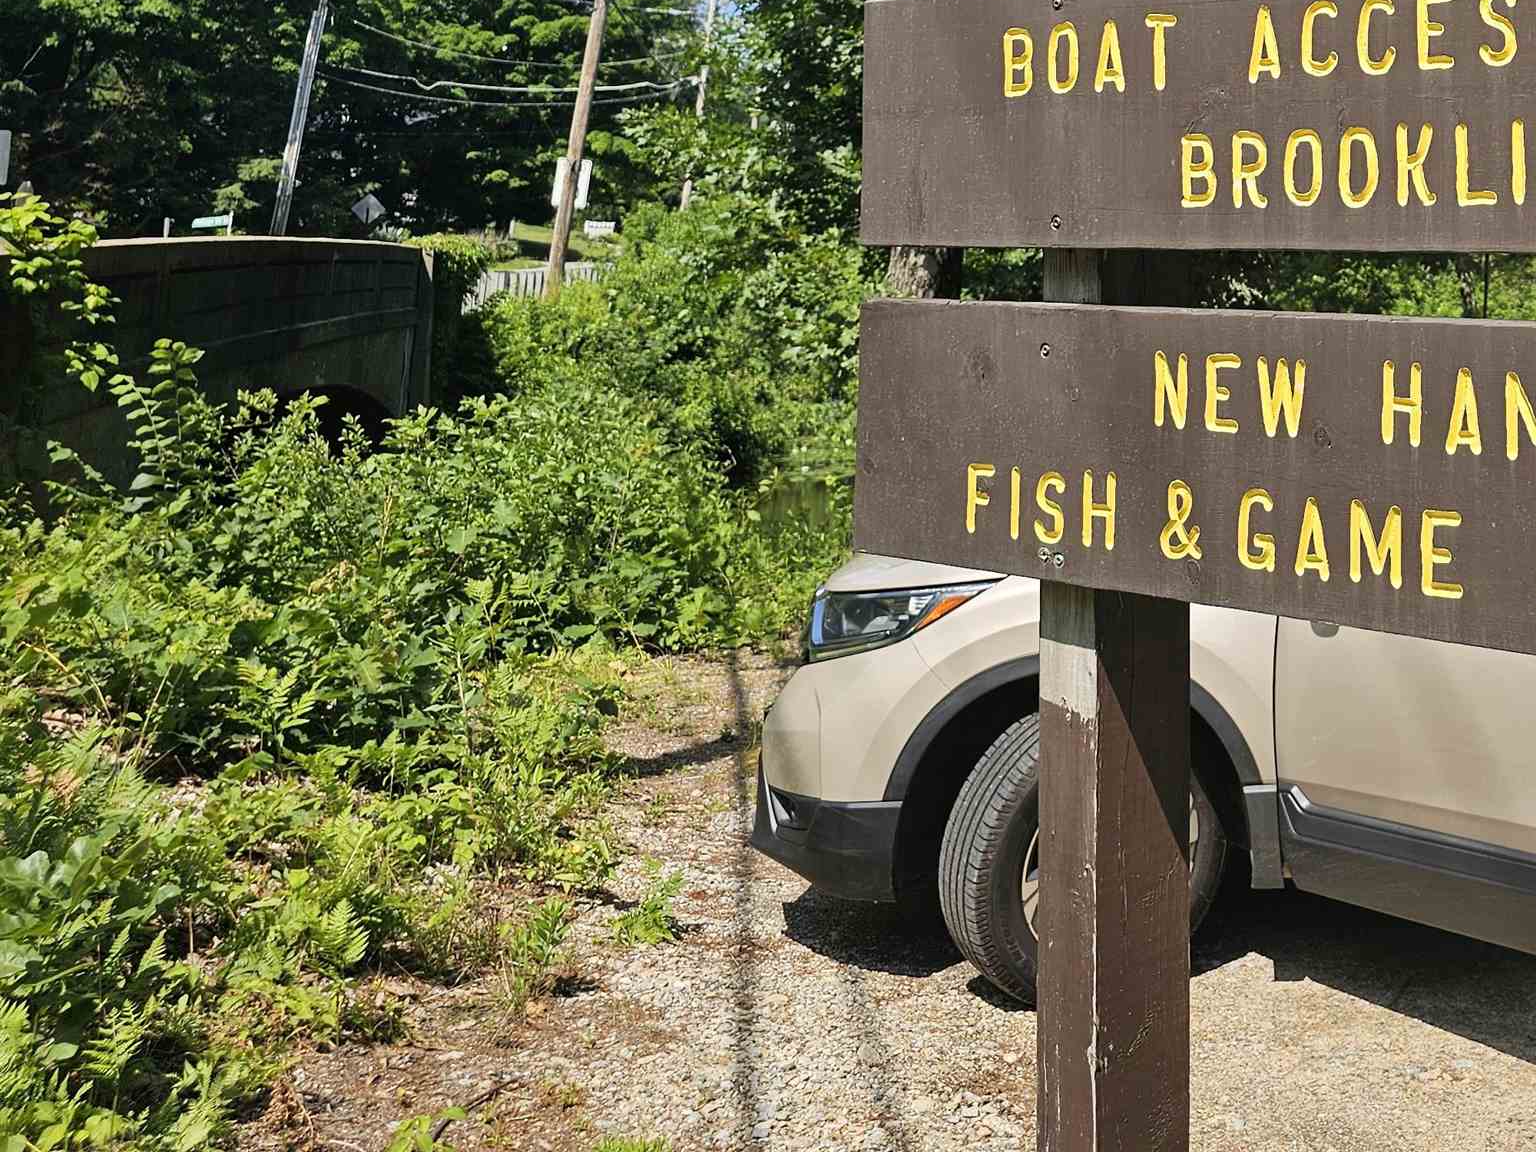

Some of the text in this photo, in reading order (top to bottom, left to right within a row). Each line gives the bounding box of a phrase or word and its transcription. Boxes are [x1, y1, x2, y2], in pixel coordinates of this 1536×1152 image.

[1001, 9, 1179, 98] BOAT
[1152, 350, 1308, 440] NEW
[964, 461, 1118, 551] FISH
[1158, 478, 1204, 562] &
[1236, 487, 1465, 600] GAME
